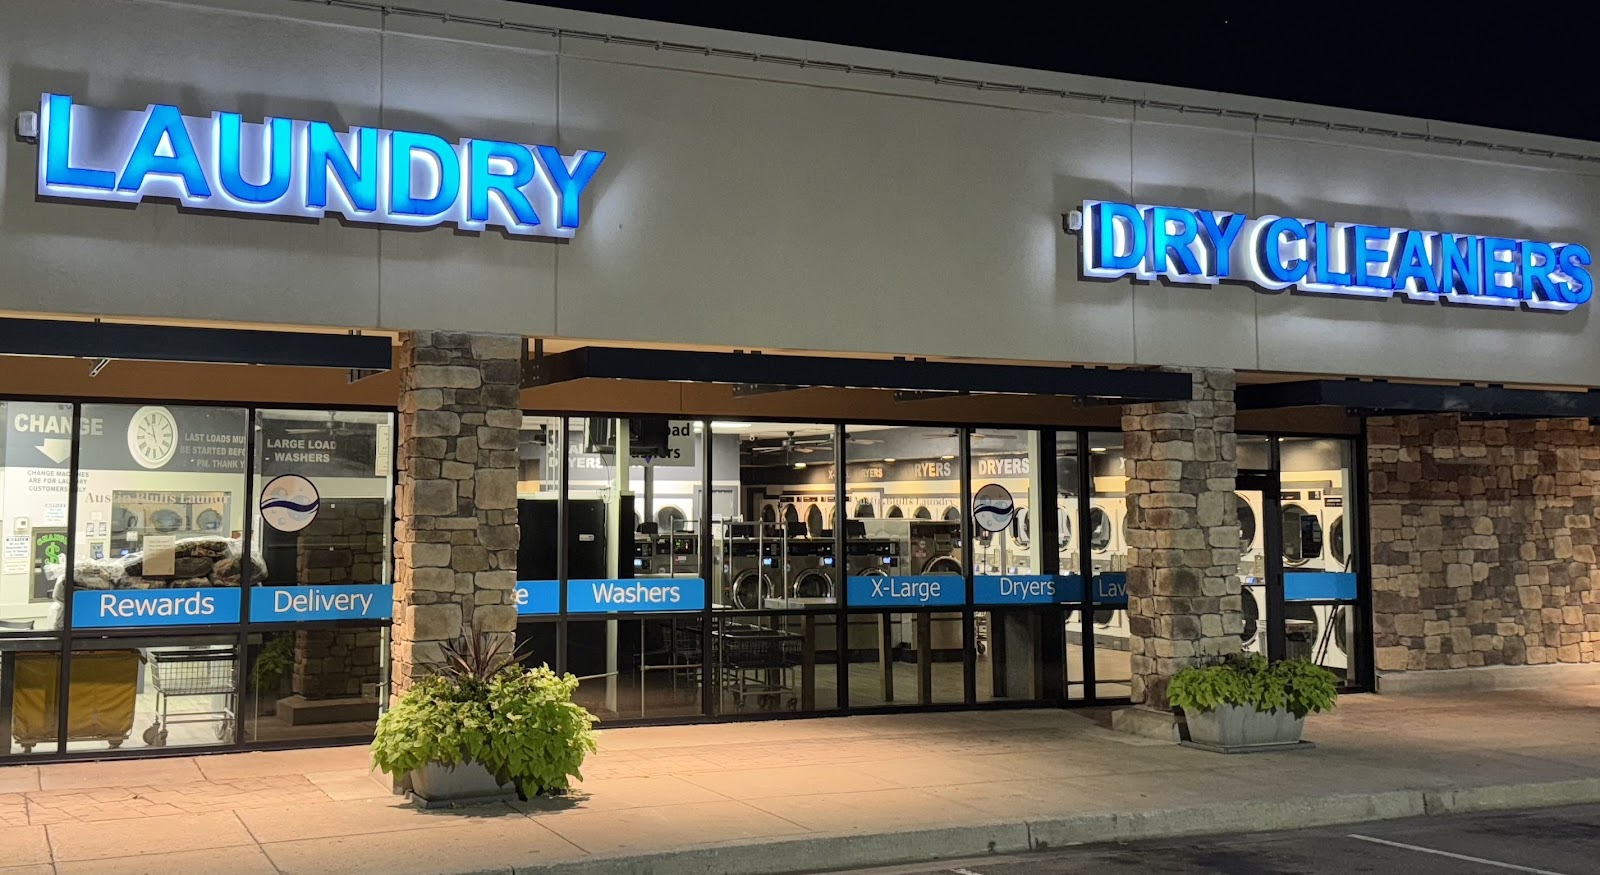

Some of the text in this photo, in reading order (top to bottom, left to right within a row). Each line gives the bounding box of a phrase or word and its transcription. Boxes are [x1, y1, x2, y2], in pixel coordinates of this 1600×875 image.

[43, 93, 607, 230] LAUNDRY
[1090, 203, 1593, 304] DRY CLEANERS
[14, 413, 103, 436] CHANGE
[184, 433, 205, 442] LAST
[206, 434, 231, 443] LOADS
[266, 438, 337, 451] LARGE LOAD
[180, 446, 191, 454] BE
[192, 446, 227, 455] STARTED
[274, 452, 331, 463] WASHERS
[212, 459, 239, 469] THANK
[549, 456, 604, 469] DYERS
[912, 461, 952, 477] RYERS
[978, 457, 1030, 475] DRYERS
[27, 469, 55, 477] CHANGE
[28, 485, 69, 493] CUSTOMERS
[592, 582, 681, 604] Washers
[871, 577, 941, 601] X-Large
[1000, 577, 1056, 601] Dryers
[100, 588, 373, 617] Rewards Delivery
